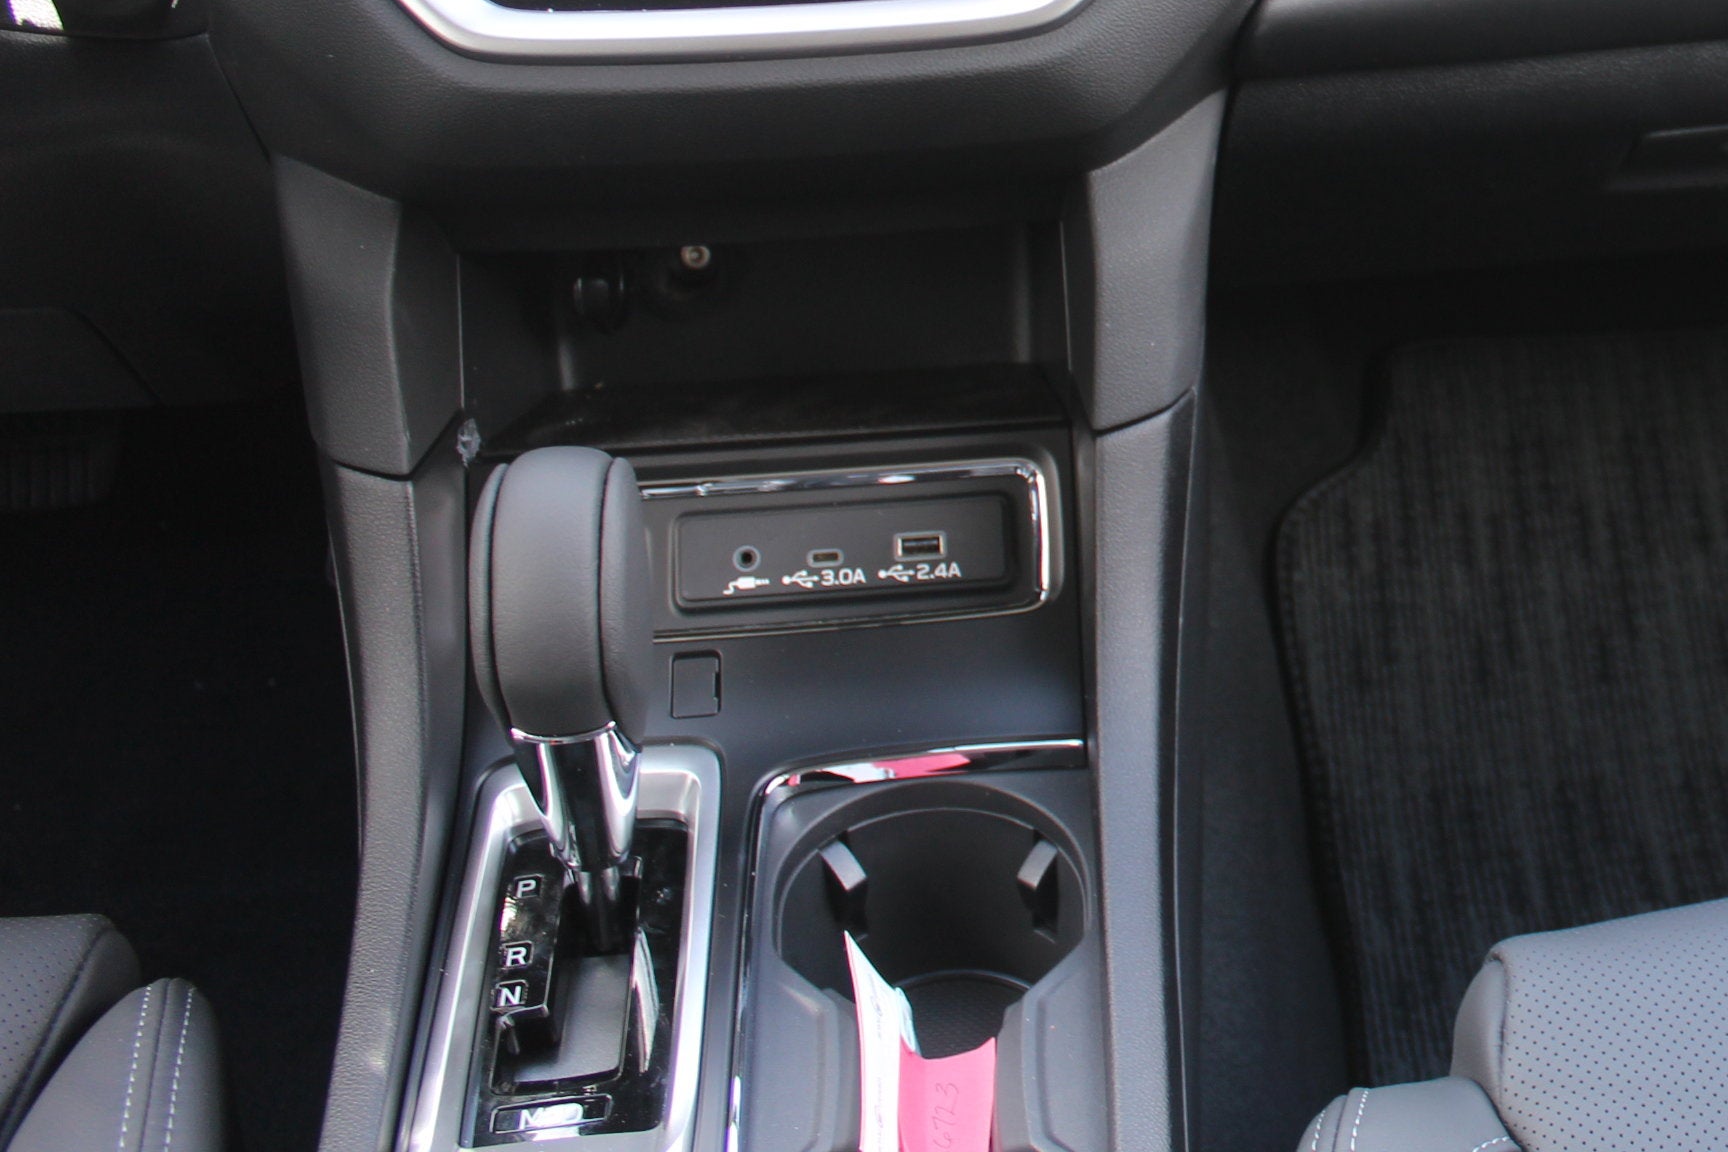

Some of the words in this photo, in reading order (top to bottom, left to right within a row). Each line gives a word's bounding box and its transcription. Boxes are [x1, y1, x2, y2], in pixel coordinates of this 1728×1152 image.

[820, 568, 866, 586] 3.0A
[916, 562, 962, 580] 2.4A
[516, 878, 537, 899] P
[505, 946, 527, 968] R
[500, 985, 522, 1007] N
